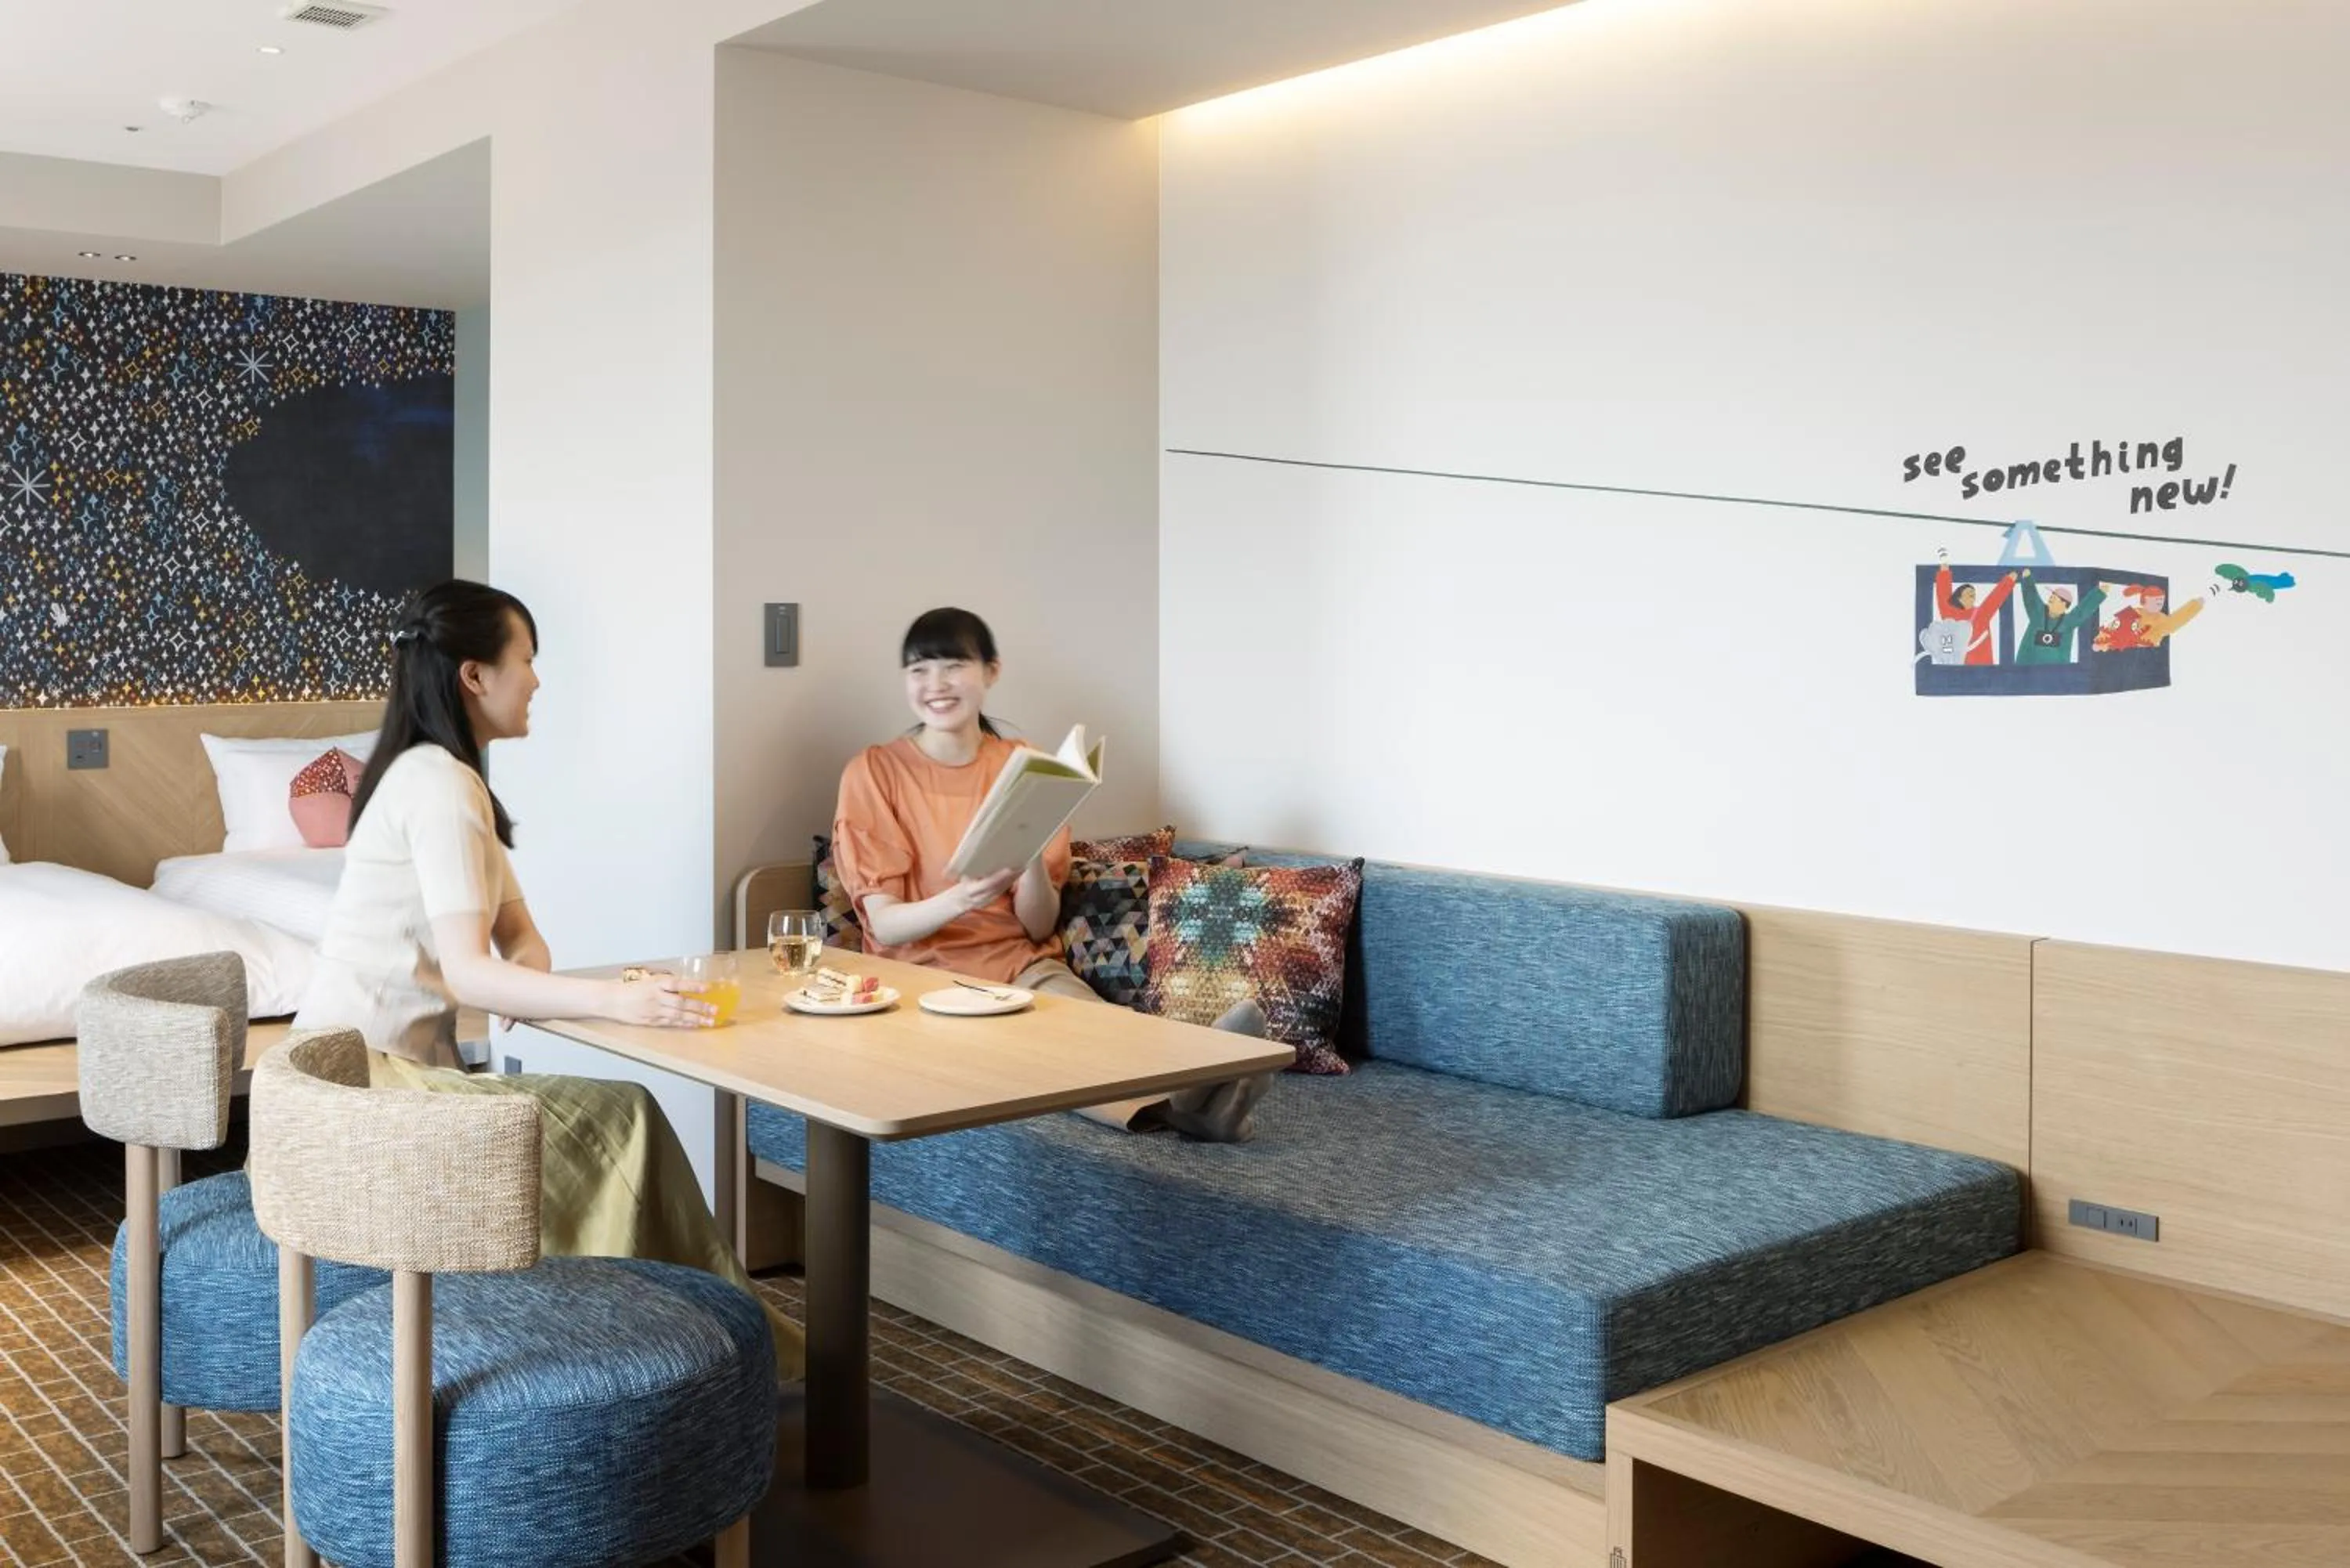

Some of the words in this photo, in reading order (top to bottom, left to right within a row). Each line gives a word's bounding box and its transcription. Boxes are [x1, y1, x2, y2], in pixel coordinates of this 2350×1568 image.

[1903, 446, 1966, 482] see
[1961, 436, 2184, 500] something
[2130, 463, 2237, 515] new!
